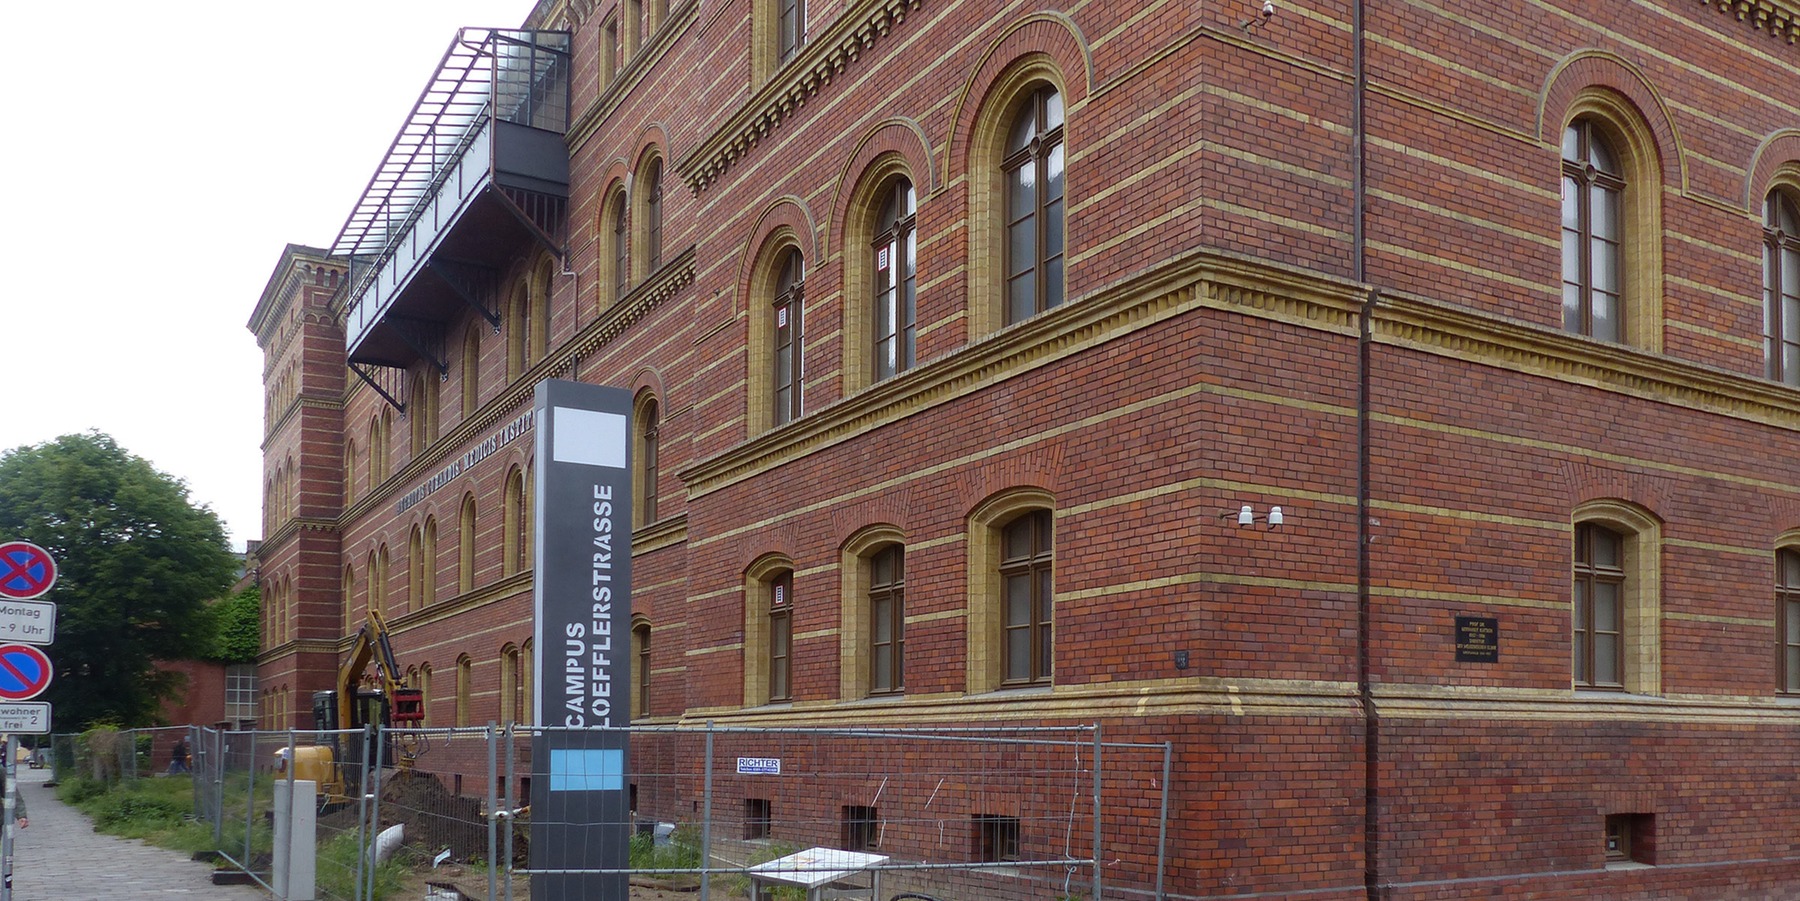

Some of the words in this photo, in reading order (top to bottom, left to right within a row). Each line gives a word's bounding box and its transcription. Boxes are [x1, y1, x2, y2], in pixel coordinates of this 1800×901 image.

[592, 484, 612, 730] LOEFFLERSTRASSE
[9, 623, 16, 632] 9
[22, 625, 45, 635] Uhr
[565, 622, 585, 730] CAMPUS
[4, 720, 23, 729] frei
[30, 715, 38, 725] 2
[738, 758, 778, 767] RICHTER
